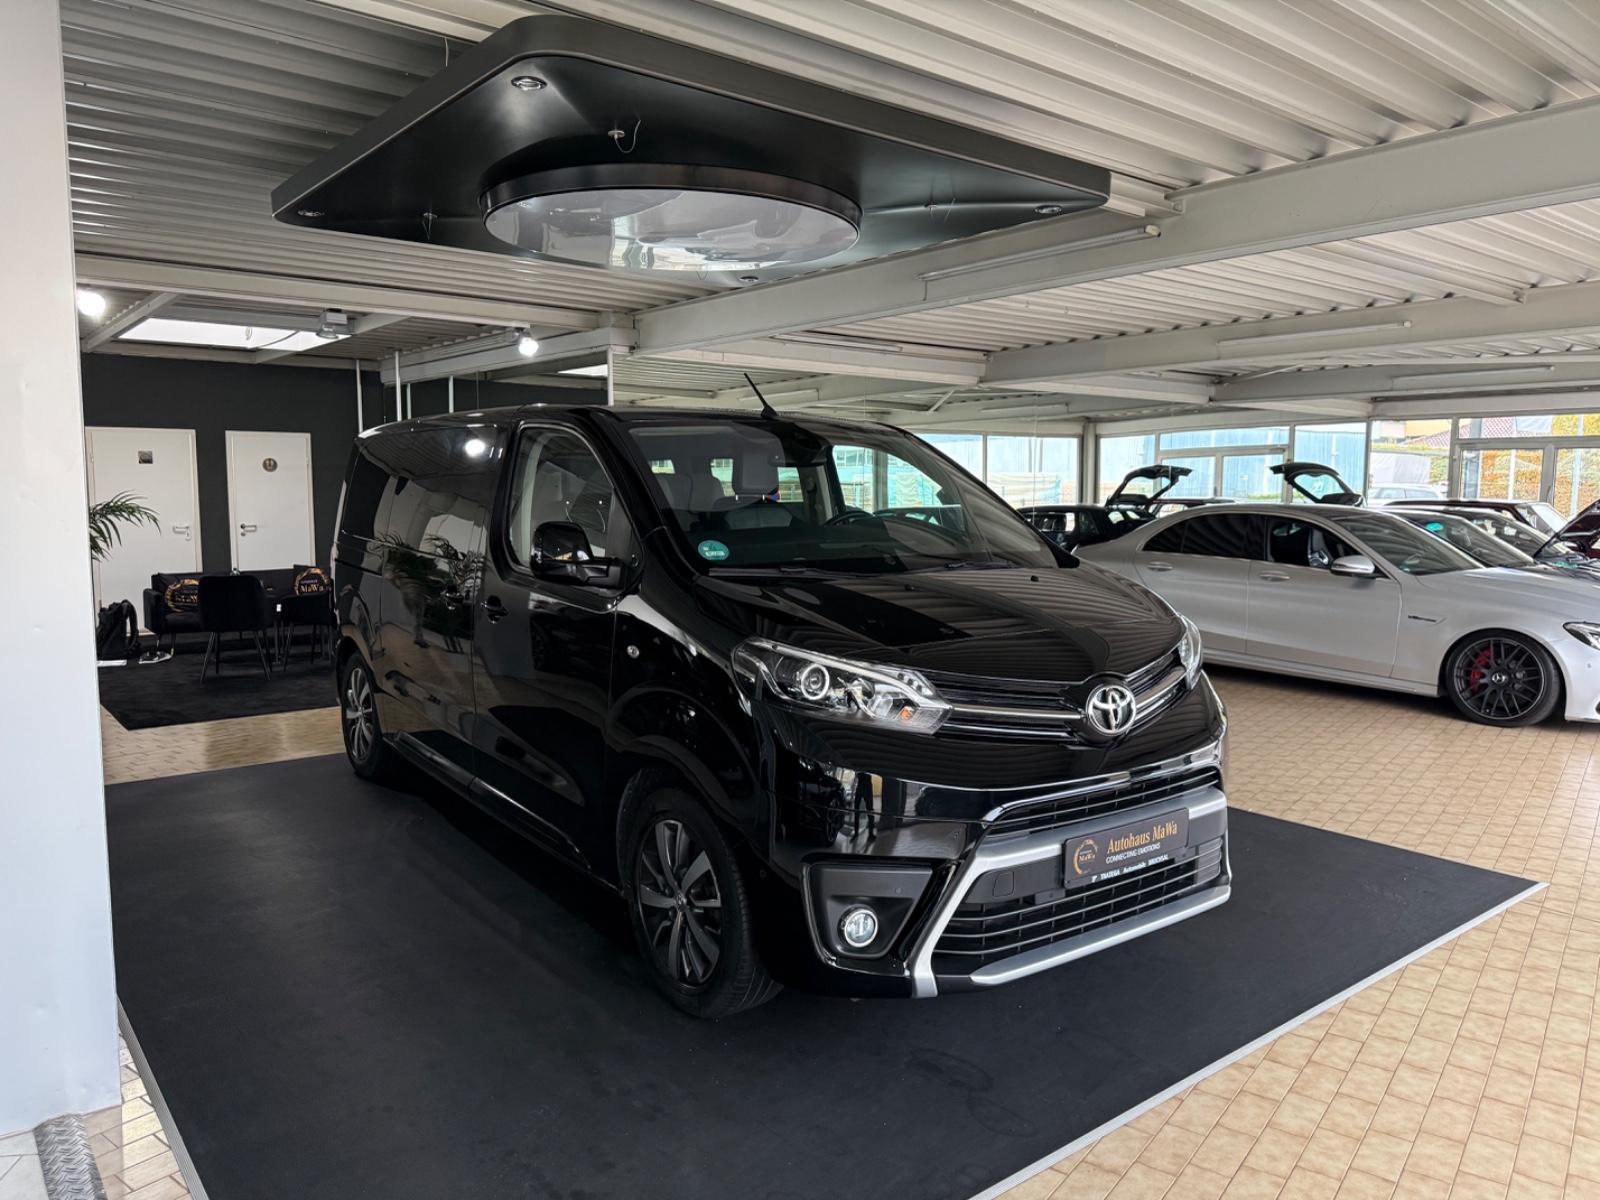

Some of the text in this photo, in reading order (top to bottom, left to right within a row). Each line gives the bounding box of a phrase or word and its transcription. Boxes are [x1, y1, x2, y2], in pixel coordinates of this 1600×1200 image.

[300, 584, 324, 593] MaWa
[1107, 820, 1178, 854] Autohaus MaWa
[1105, 848, 1138, 865] CONNECTING
